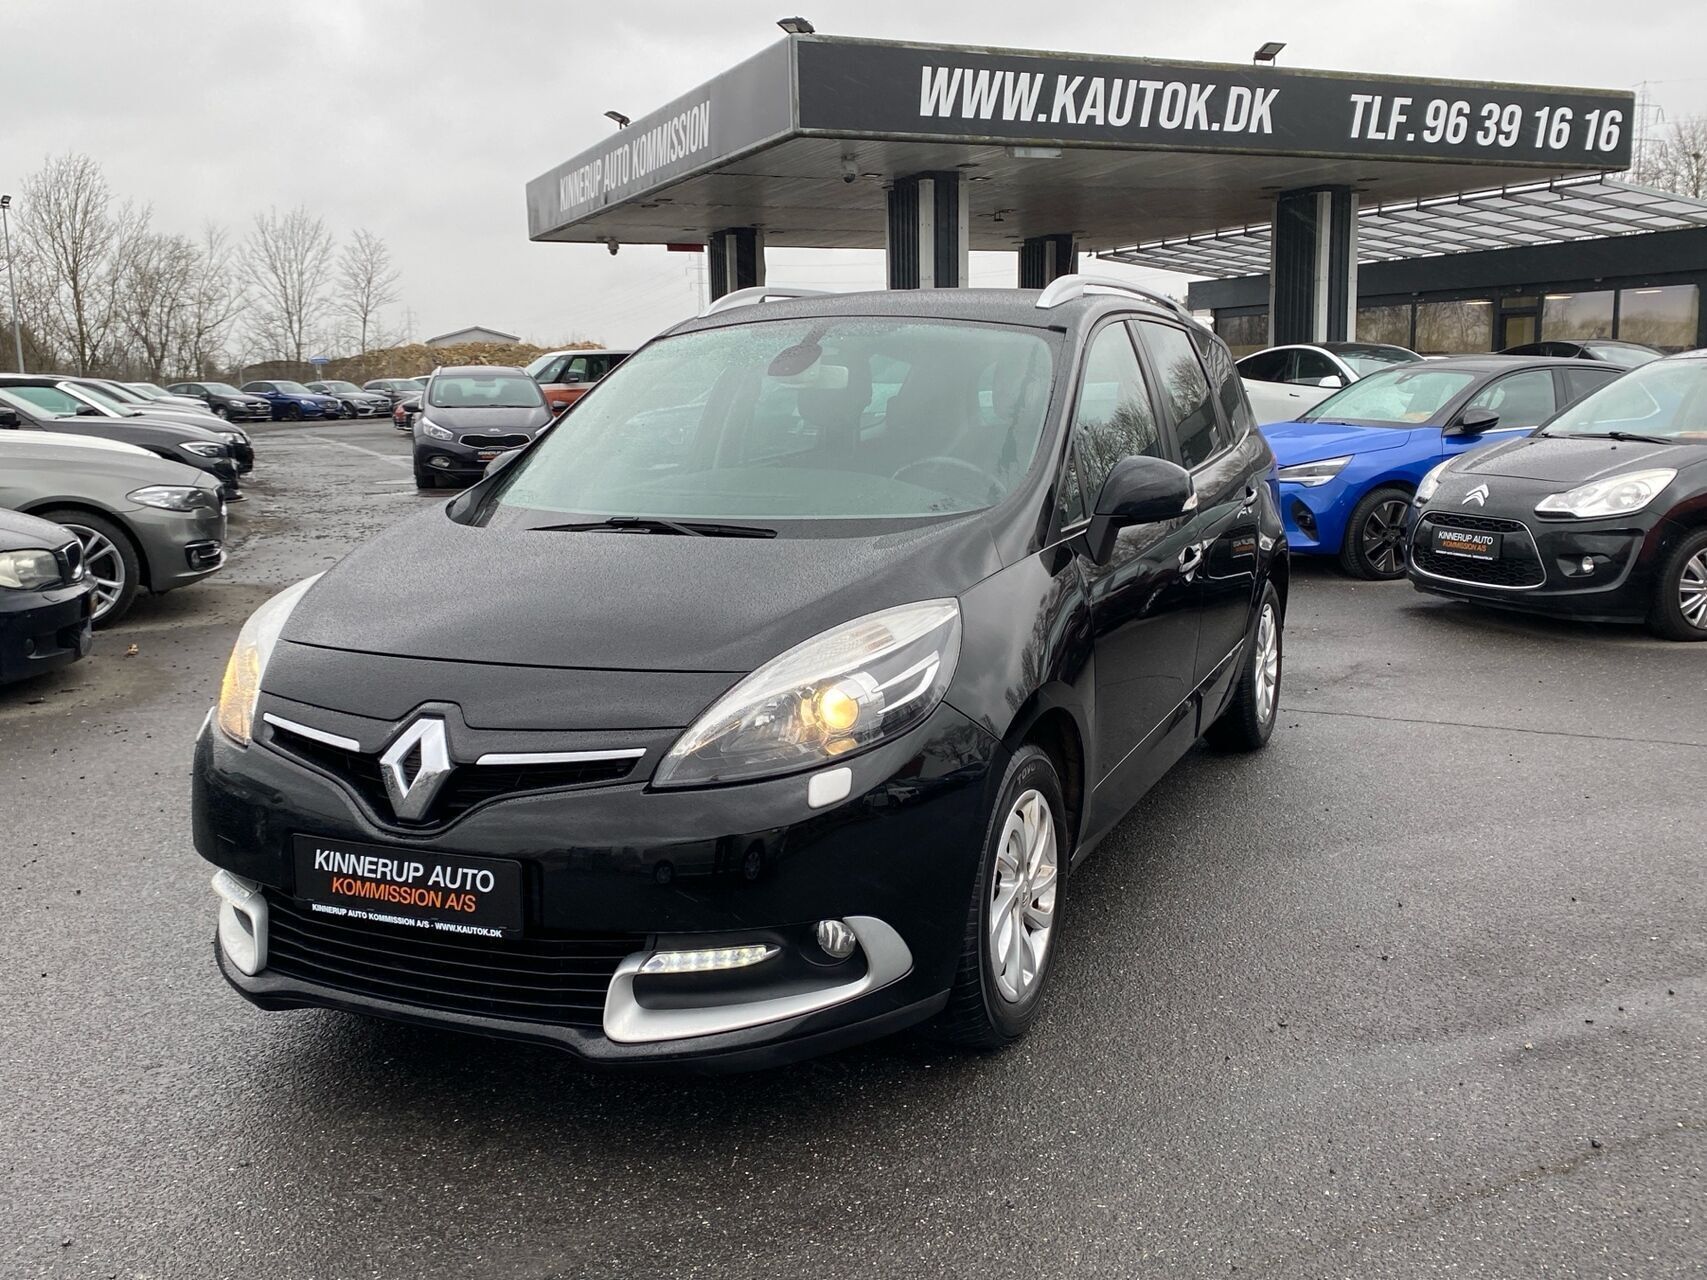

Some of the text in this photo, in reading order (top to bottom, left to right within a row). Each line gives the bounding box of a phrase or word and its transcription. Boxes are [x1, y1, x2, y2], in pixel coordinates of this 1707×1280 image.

[919, 66, 1280, 134] WWW.KAUTOK.DK
[1349, 94, 1623, 152] TLF. 96 39 16 16
[559, 101, 710, 212] KINNERUP AUTO KOMMISSION
[1438, 531, 1493, 545] KINNERUP AUTO
[314, 849, 495, 893] KINNERUP AUTO
[332, 877, 476, 912] KOMMISSION A/S
[312, 903, 347, 916] KINNERUP
[347, 910, 367, 919] AUTO
[368, 913, 415, 927] KOMMISSION
[416, 920, 430, 929] A/S
[435, 922, 502, 938] WWW.KAUTOK.DK
